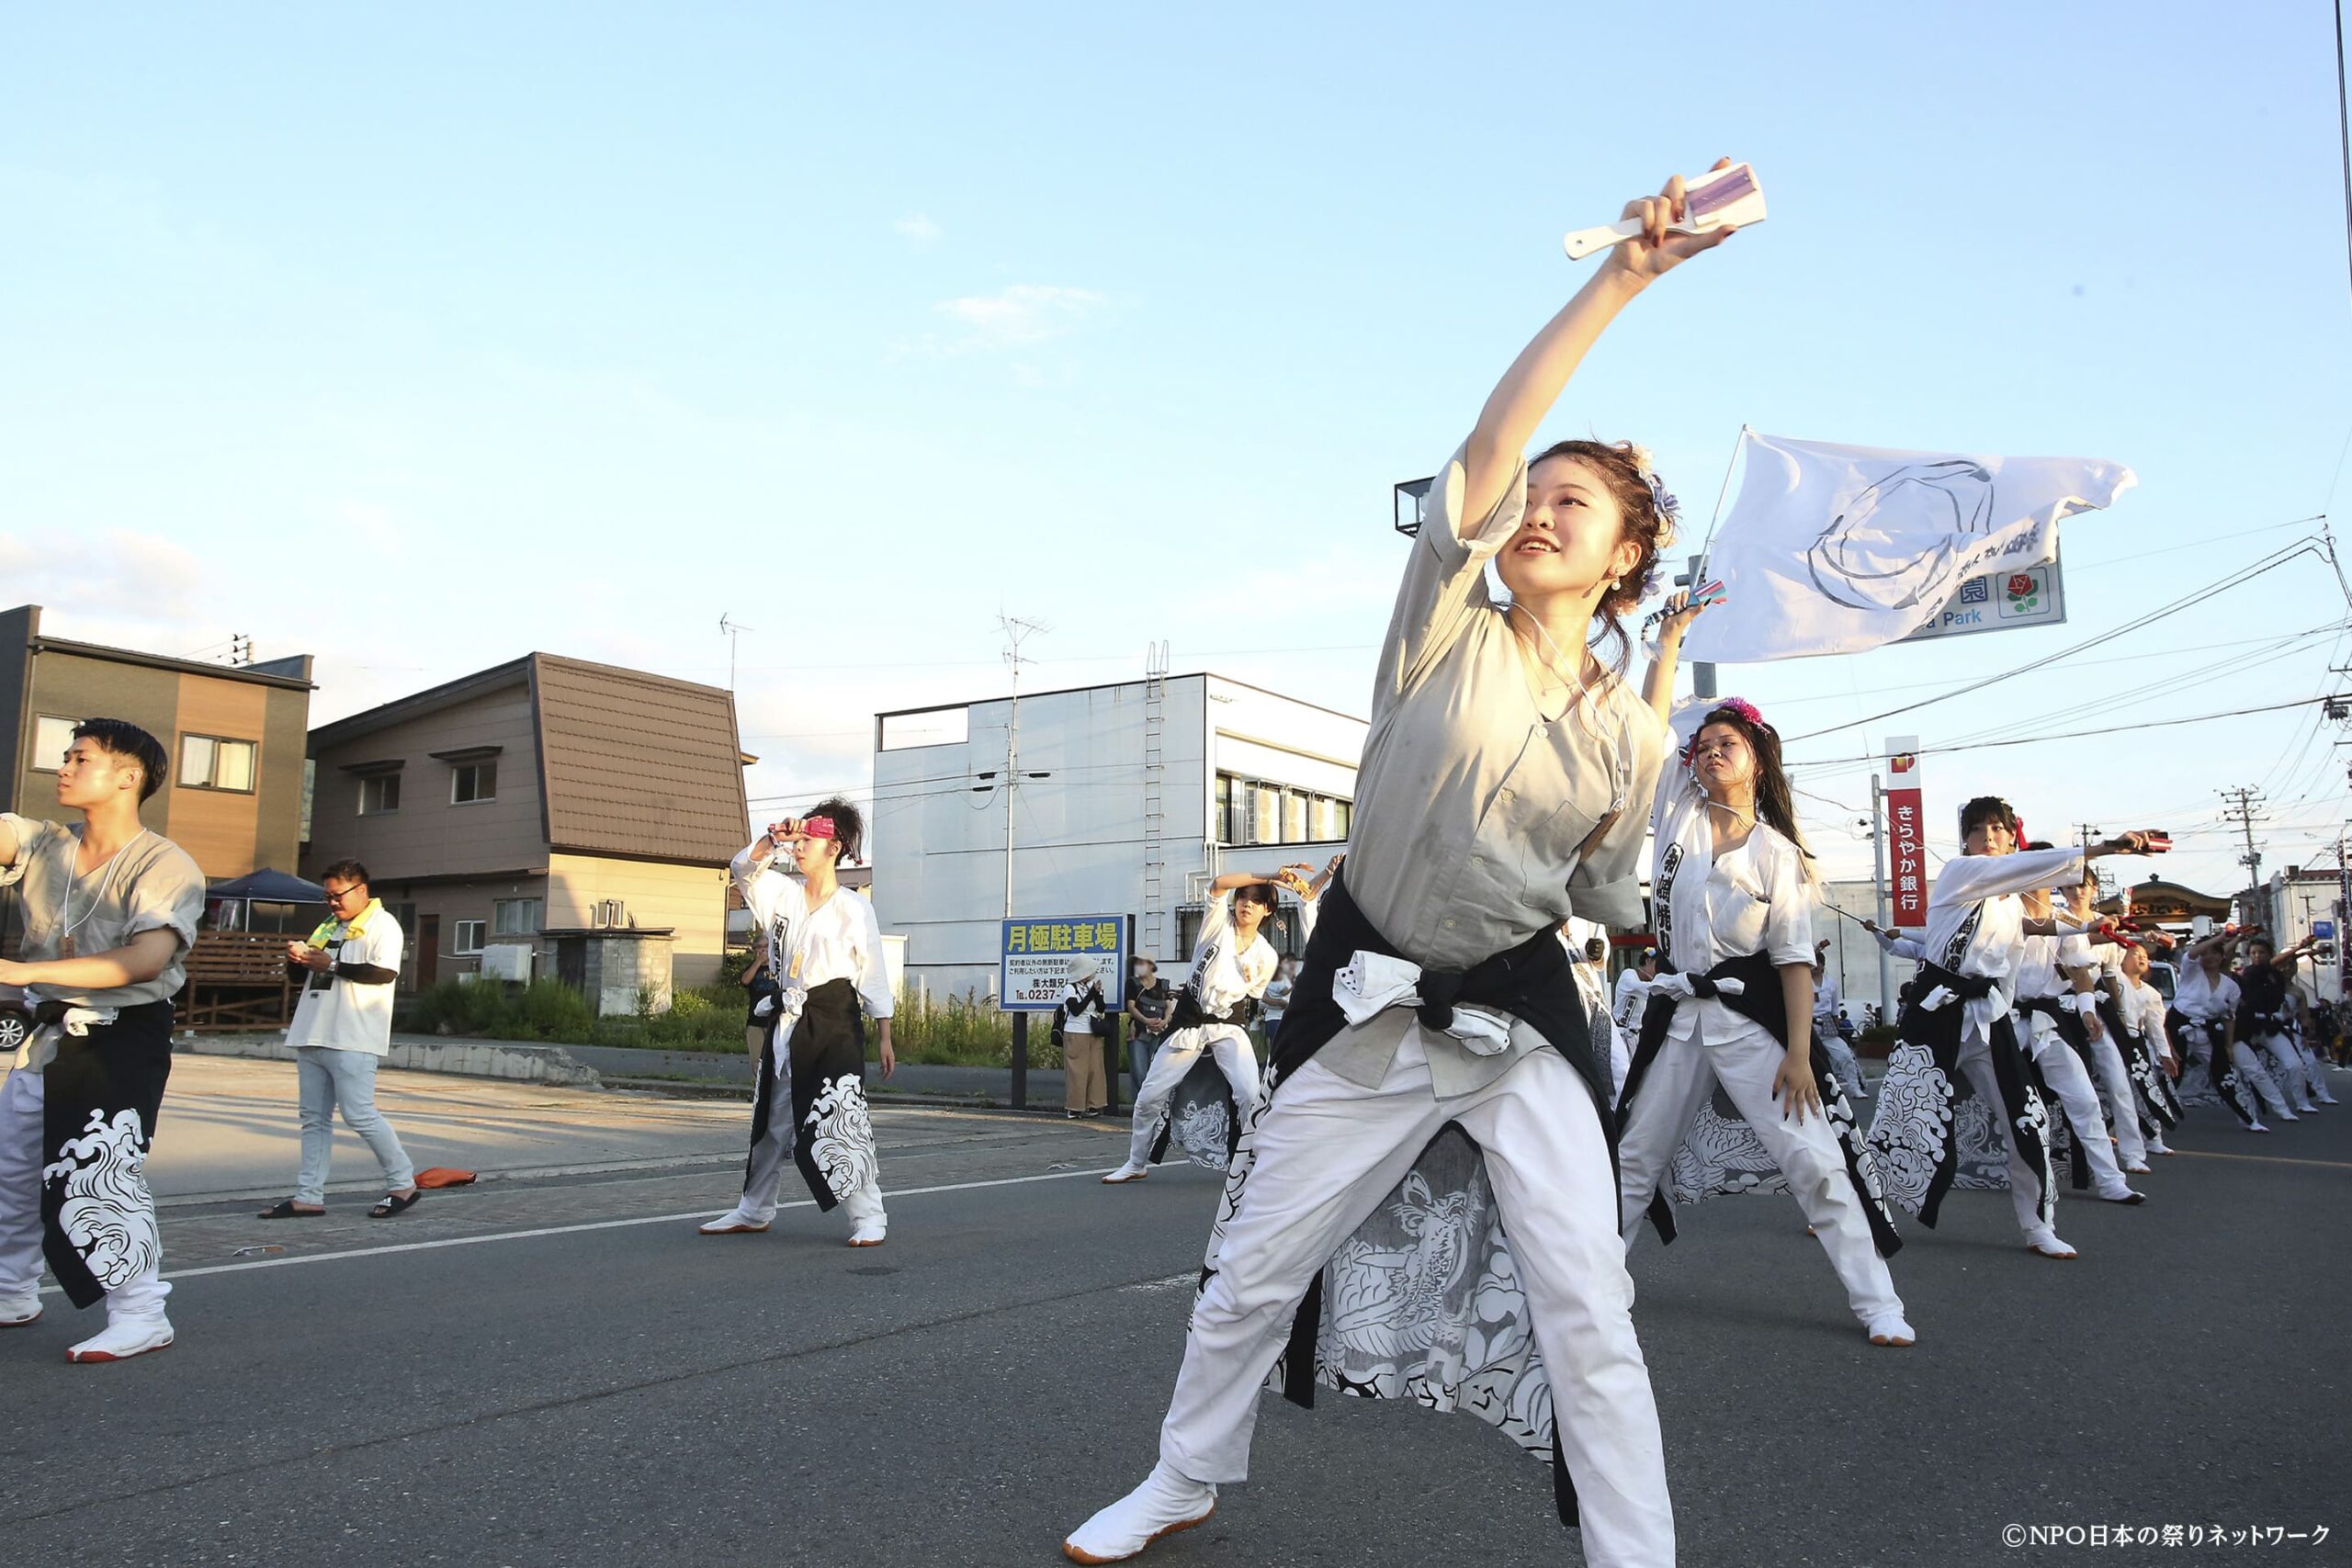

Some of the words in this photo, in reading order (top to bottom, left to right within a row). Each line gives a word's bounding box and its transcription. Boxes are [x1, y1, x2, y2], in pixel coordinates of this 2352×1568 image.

[1961, 575, 1988, 604] 園
[1943, 608, 1983, 626] Park
[1896, 806, 1919, 910] きらやか銀行
[1007, 922, 1118, 952] 月極駐車場
